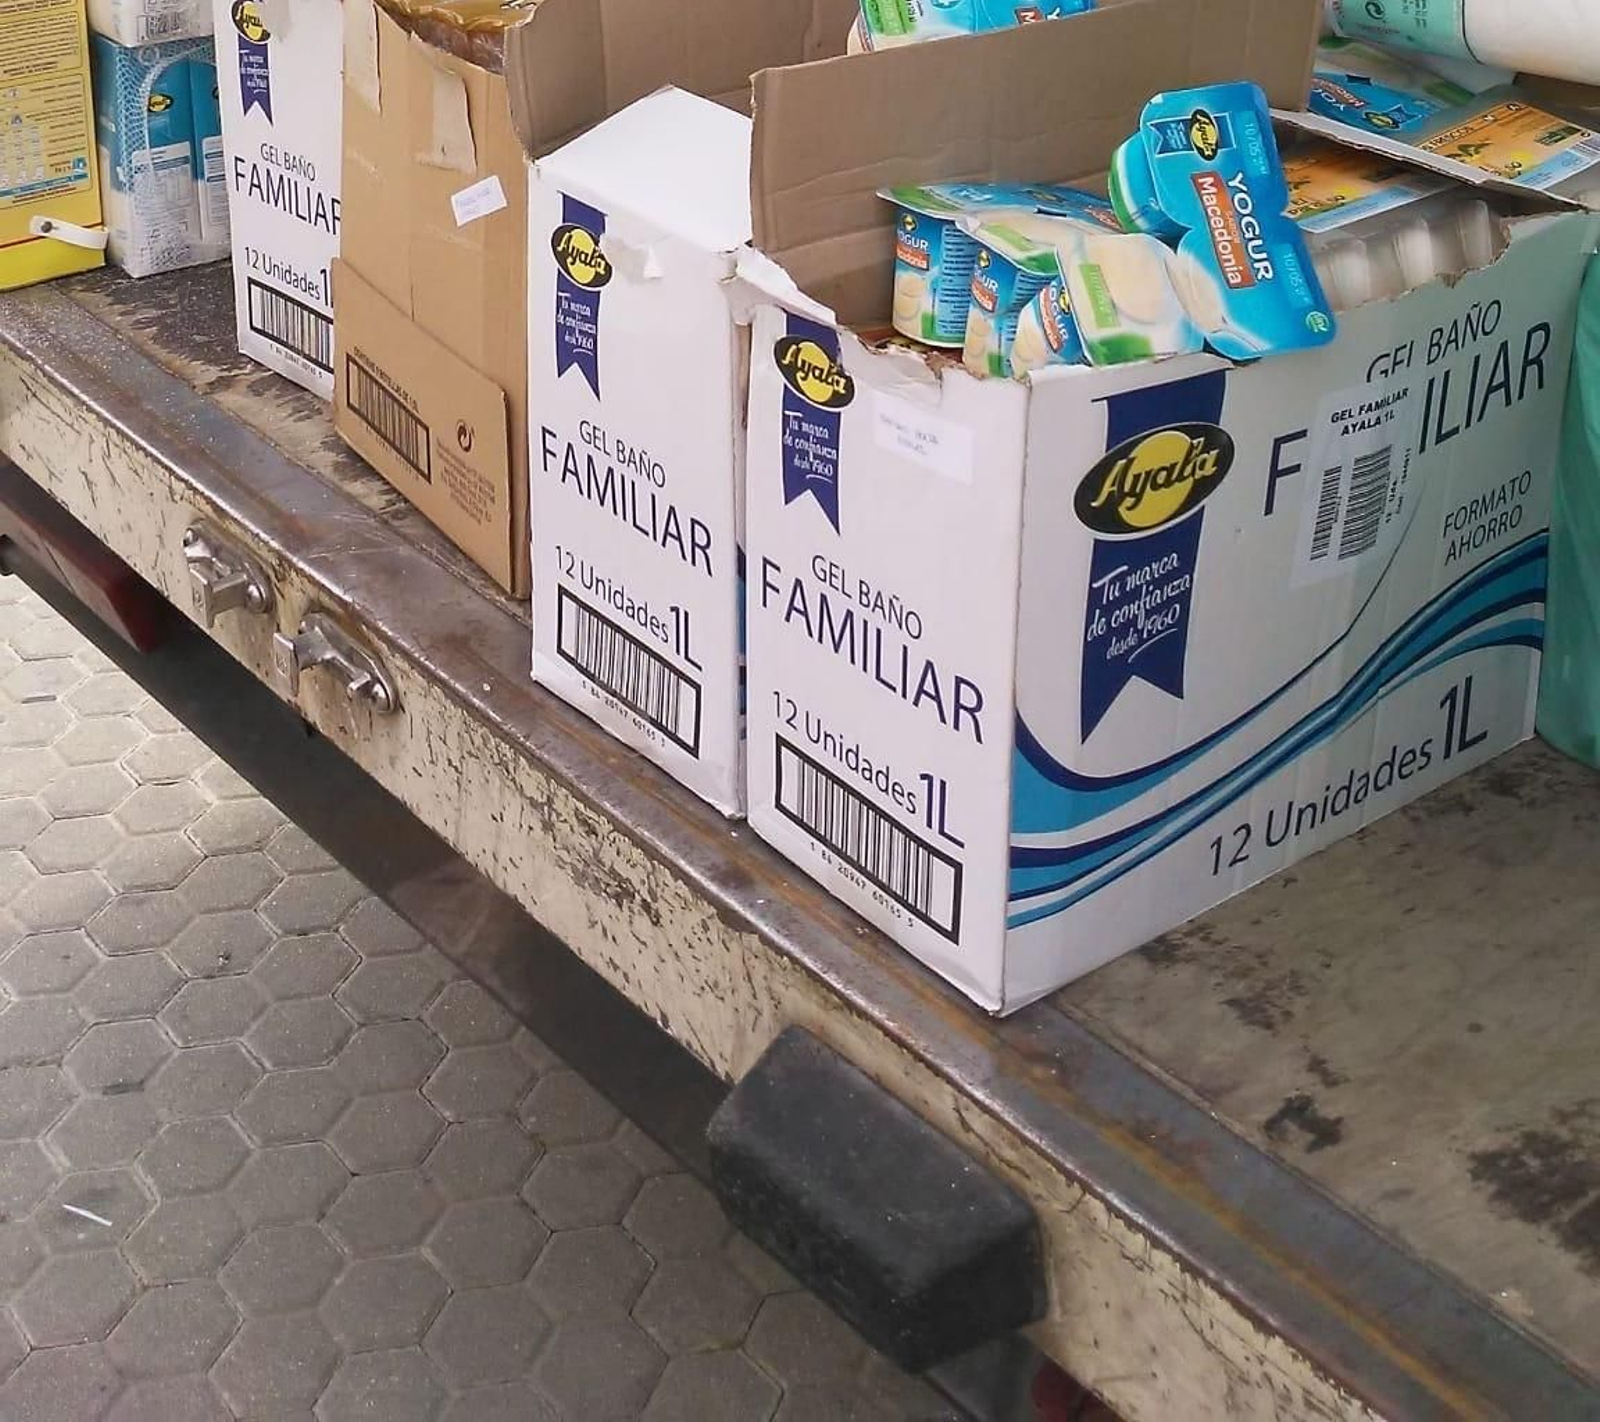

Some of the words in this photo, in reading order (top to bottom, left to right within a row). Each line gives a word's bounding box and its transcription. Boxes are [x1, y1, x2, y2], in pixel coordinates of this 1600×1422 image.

[260, 143, 282, 167] GEL
[284, 152, 316, 182] BAÑO
[1194, 112, 1219, 158] Ayala
[557, 231, 607, 276] Ayala
[898, 230, 929, 251] OGUR
[1197, 176, 1242, 287] Macedonia
[1227, 171, 1275, 281] YOGUR
[244, 246, 260, 269] 12
[262, 253, 321, 300] Unidades
[1426, 299, 1502, 366] BAÑO
[782, 344, 847, 395] Ayala
[784, 410, 803, 431] Tu
[801, 421, 829, 440] marca
[1263, 321, 1551, 517] FILIAR
[1331, 407, 1355, 424] GEL
[1358, 388, 1409, 416] FAMILIAR
[1341, 415, 1382, 437] AYALA
[1384, 409, 1395, 423] 1L
[579, 419, 611, 457] GEL
[615, 435, 666, 489] BAÑO
[783, 428, 794, 447] de
[794, 435, 837, 462] confianza
[810, 462, 834, 477] 1960
[540, 424, 714, 578] FAMILIAR
[1088, 437, 1221, 517] Ayala
[1443, 471, 1532, 538] FORMATO
[1444, 507, 1525, 566] AHORRO
[555, 544, 577, 579] 12
[580, 561, 670, 645] Unidades
[667, 604, 704, 672] 1L
[811, 555, 852, 601] GEL
[859, 581, 924, 641] BAÑO
[1087, 614, 1108, 642] de
[1110, 571, 1193, 629] confianza
[1091, 565, 1131, 607] Tu
[1125, 552, 1180, 595] marca
[761, 555, 984, 745] FAMILIAR
[1106, 621, 1140, 661] desde
[1138, 603, 1181, 642] 1960
[772, 690, 799, 731] 12
[804, 711, 918, 816] Unidades
[917, 771, 966, 850] 1L
[1208, 823, 1252, 876] 12
[1264, 736, 1433, 849] Unidades
[1438, 675, 1489, 762] 1L
[838, 862, 867, 890] 20947
[872, 891, 901, 918] 60165
